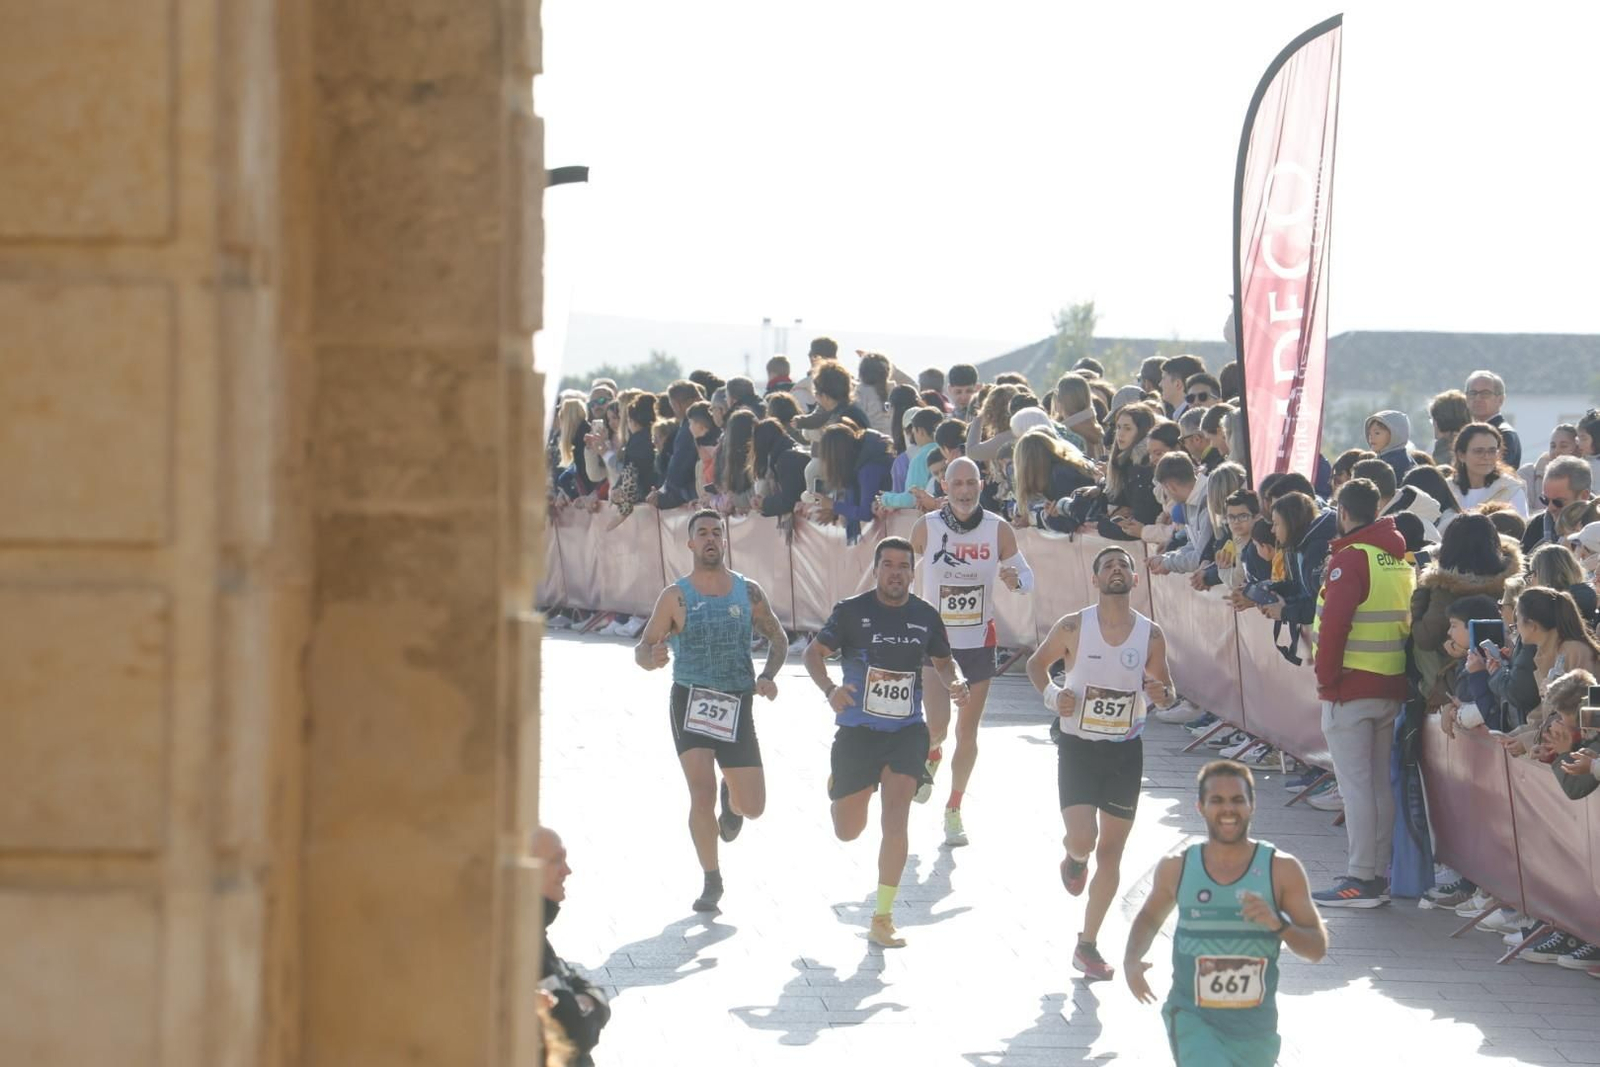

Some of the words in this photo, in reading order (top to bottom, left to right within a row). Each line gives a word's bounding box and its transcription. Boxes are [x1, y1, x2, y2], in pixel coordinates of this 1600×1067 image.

[947, 596, 977, 610] 899
[871, 683, 910, 700] 4180
[697, 702, 728, 722] 257
[1093, 700, 1127, 717] 857
[1210, 974, 1251, 993] 667
